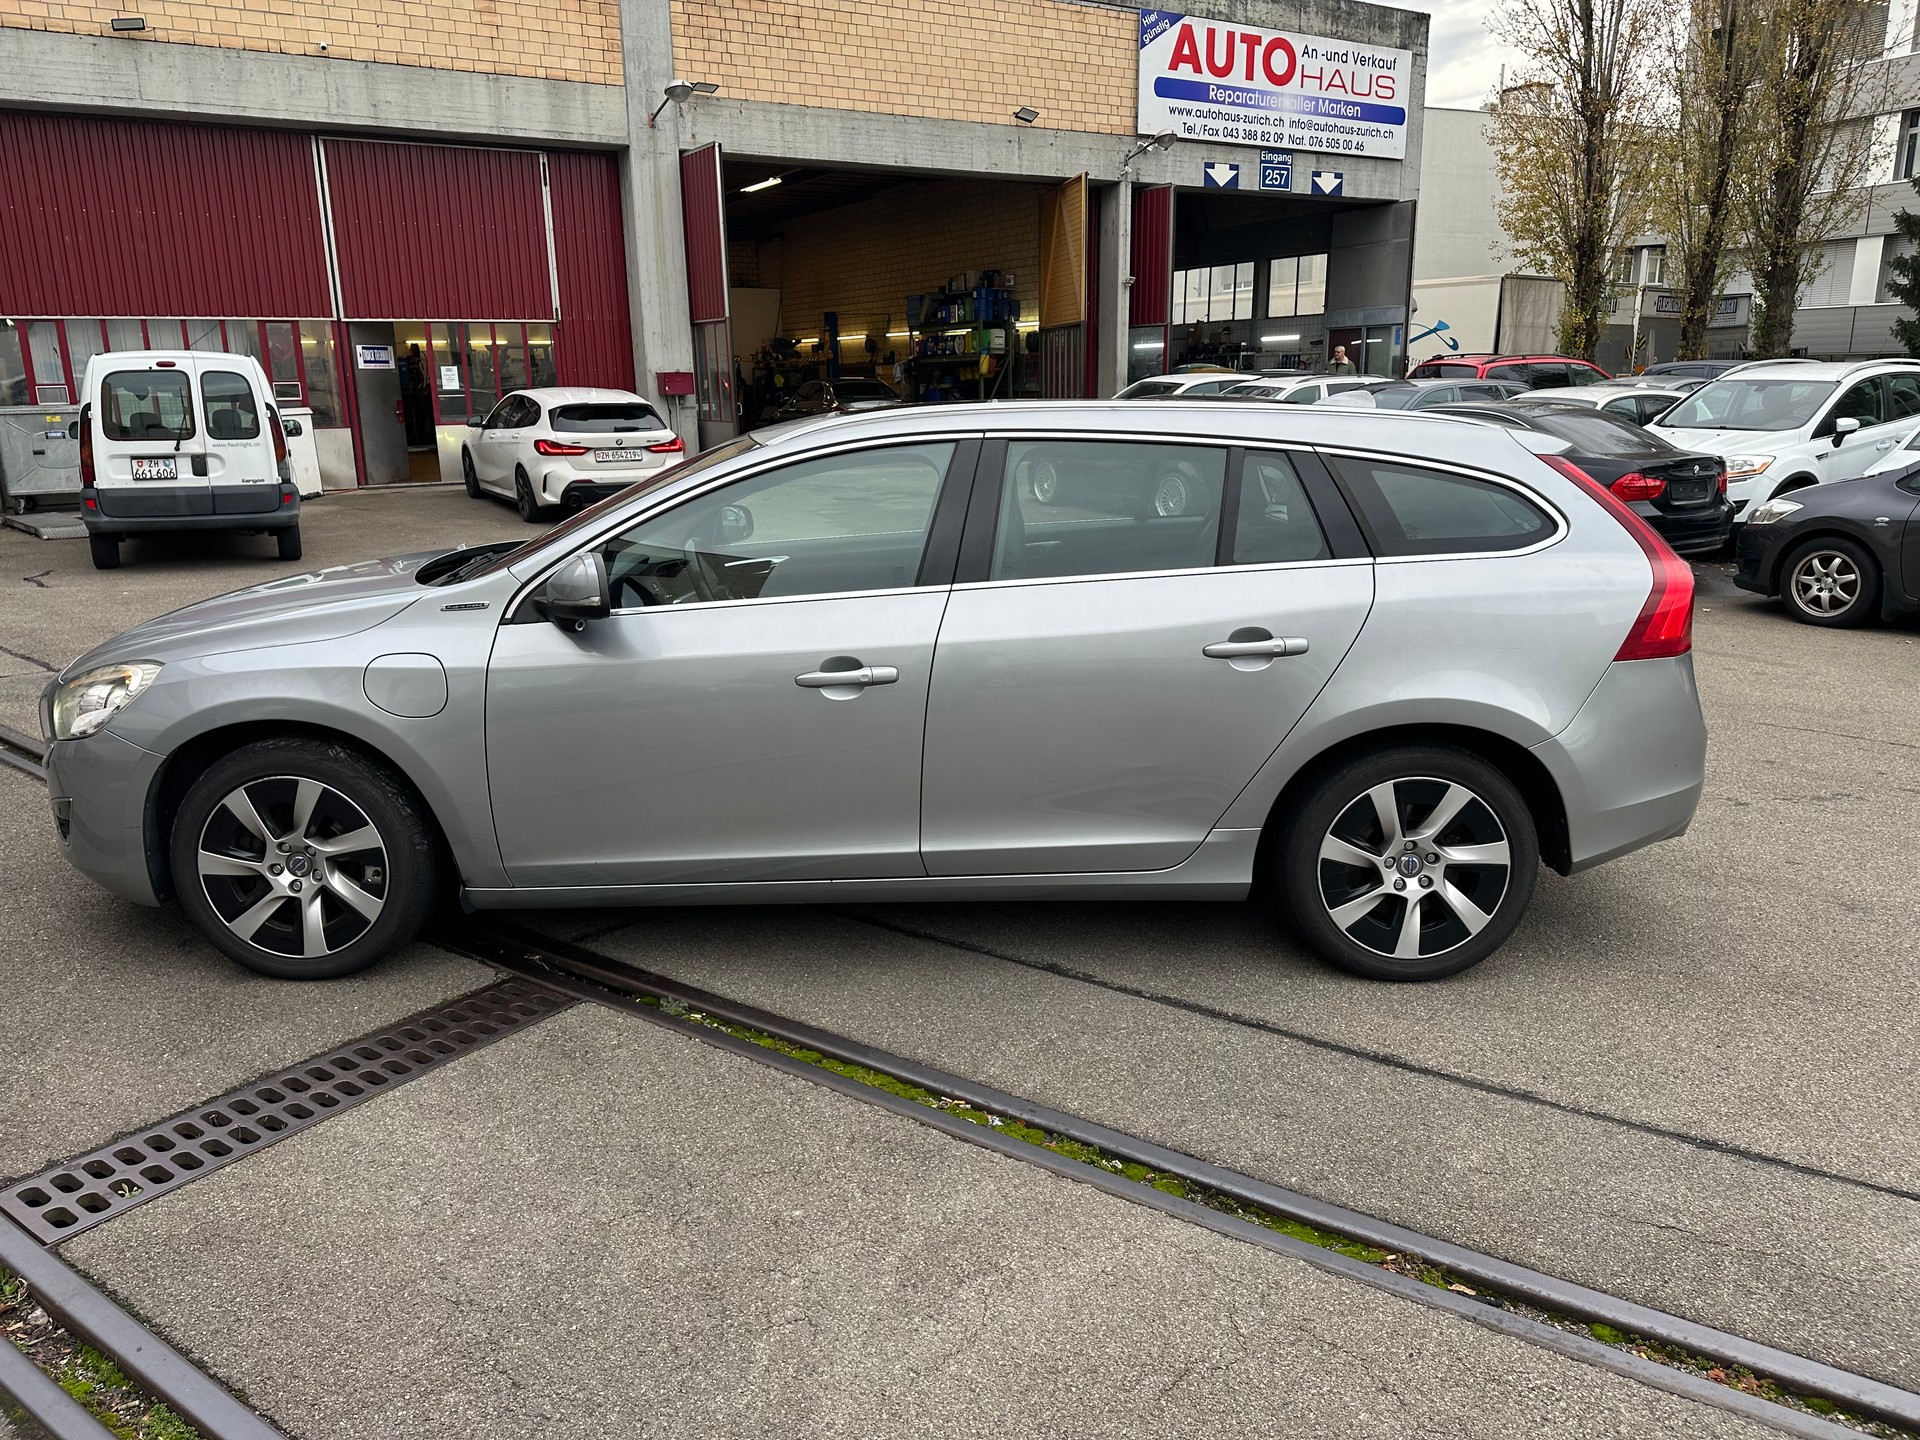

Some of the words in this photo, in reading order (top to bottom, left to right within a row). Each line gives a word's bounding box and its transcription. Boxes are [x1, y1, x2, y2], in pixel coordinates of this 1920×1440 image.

[1142, 11, 1158, 27] Hier
[1143, 19, 1171, 44] günstig
[1168, 23, 1297, 87] AUTO
[1301, 44, 1318, 60] An
[1321, 50, 1348, 64] -und
[1352, 51, 1397, 70] Verkauf
[1300, 64, 1395, 100] HAUS
[1289, 96, 1315, 112] aller
[1318, 98, 1361, 117] Marken
[1168, 105, 1285, 127] www.autohaus-zurich.ch
[1289, 117, 1394, 139] info@autohaus-zurich.ch
[1182, 122, 1220, 137] Tel./Fax
[1222, 126, 1239, 139] 043
[1242, 129, 1258, 141] 388
[1260, 131, 1271, 143] 82
[1273, 132, 1284, 144] 09
[1288, 134, 1306, 146] Nat.
[1308, 135, 1324, 148] 076
[1325, 137, 1340, 149] 505
[1342, 139, 1353, 151] 00
[1354, 140, 1365, 152] 46
[1261, 150, 1292, 165] Eingang
[1265, 169, 1288, 185] 257
[148, 459, 159, 468] ZH
